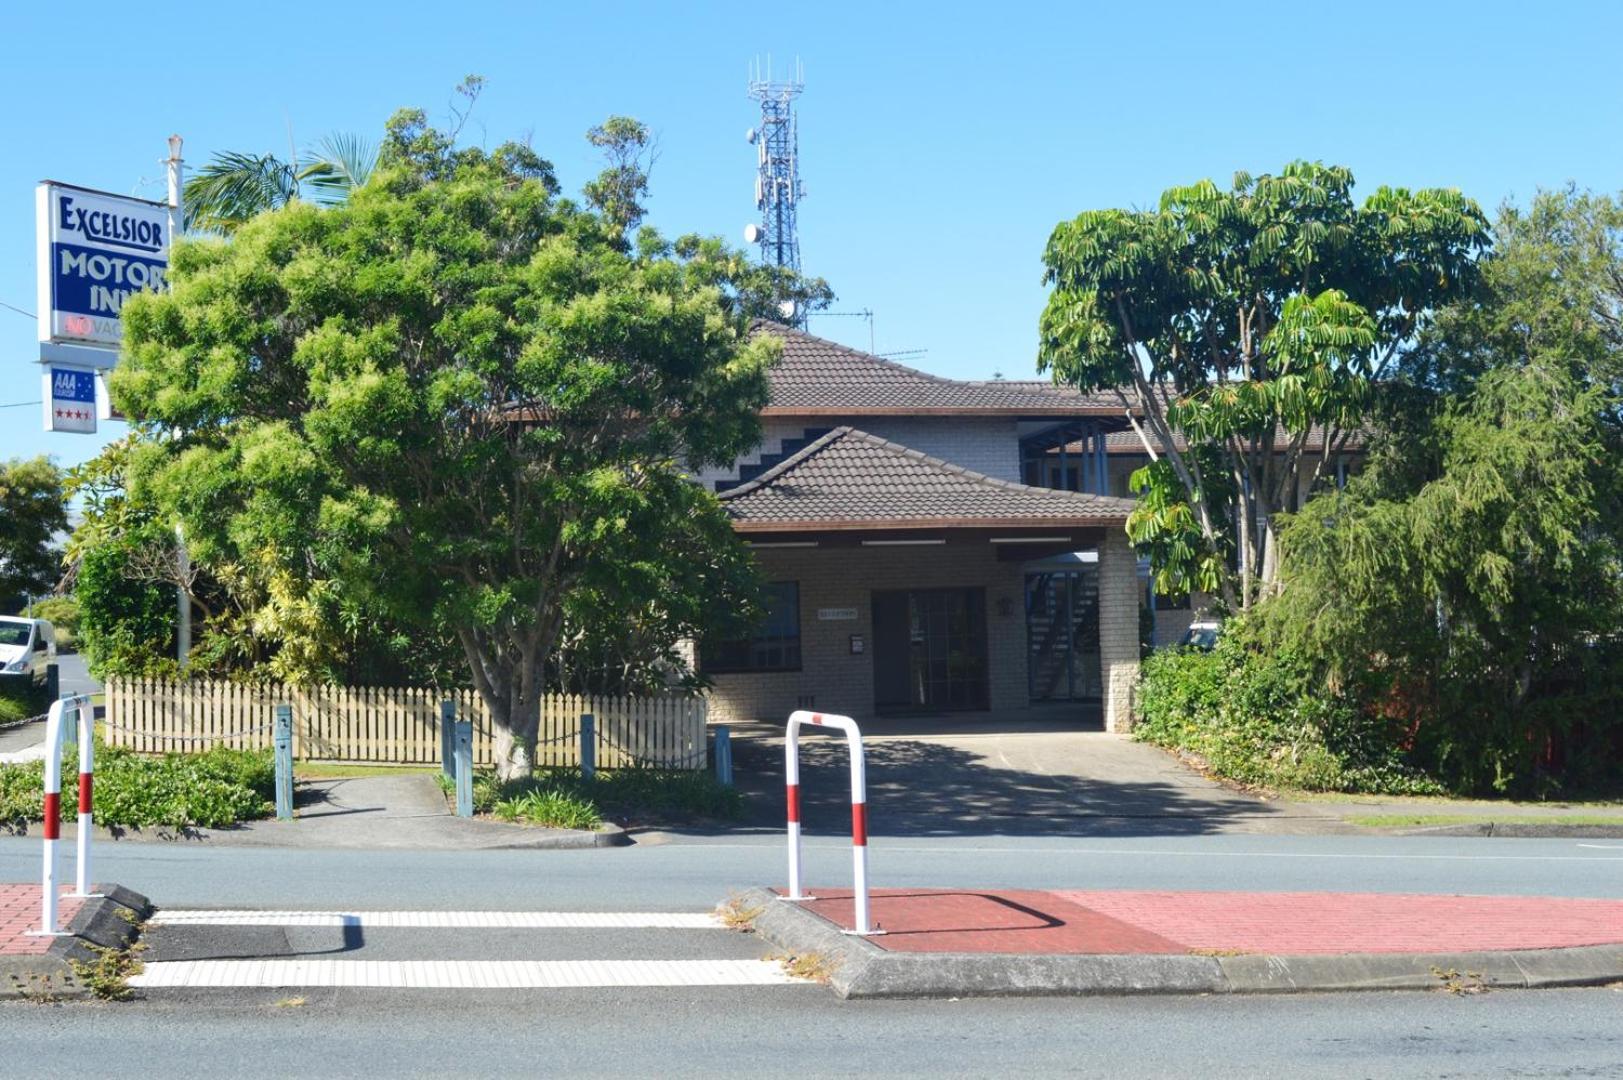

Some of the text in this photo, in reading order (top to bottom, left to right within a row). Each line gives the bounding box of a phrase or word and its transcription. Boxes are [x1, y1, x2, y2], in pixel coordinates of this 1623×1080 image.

[59, 196, 163, 251] EXCELSIOR
[60, 249, 167, 292] MOTOR
[90, 285, 132, 314] IN
[64, 315, 91, 336] NO
[54, 373, 76, 389] AAA
